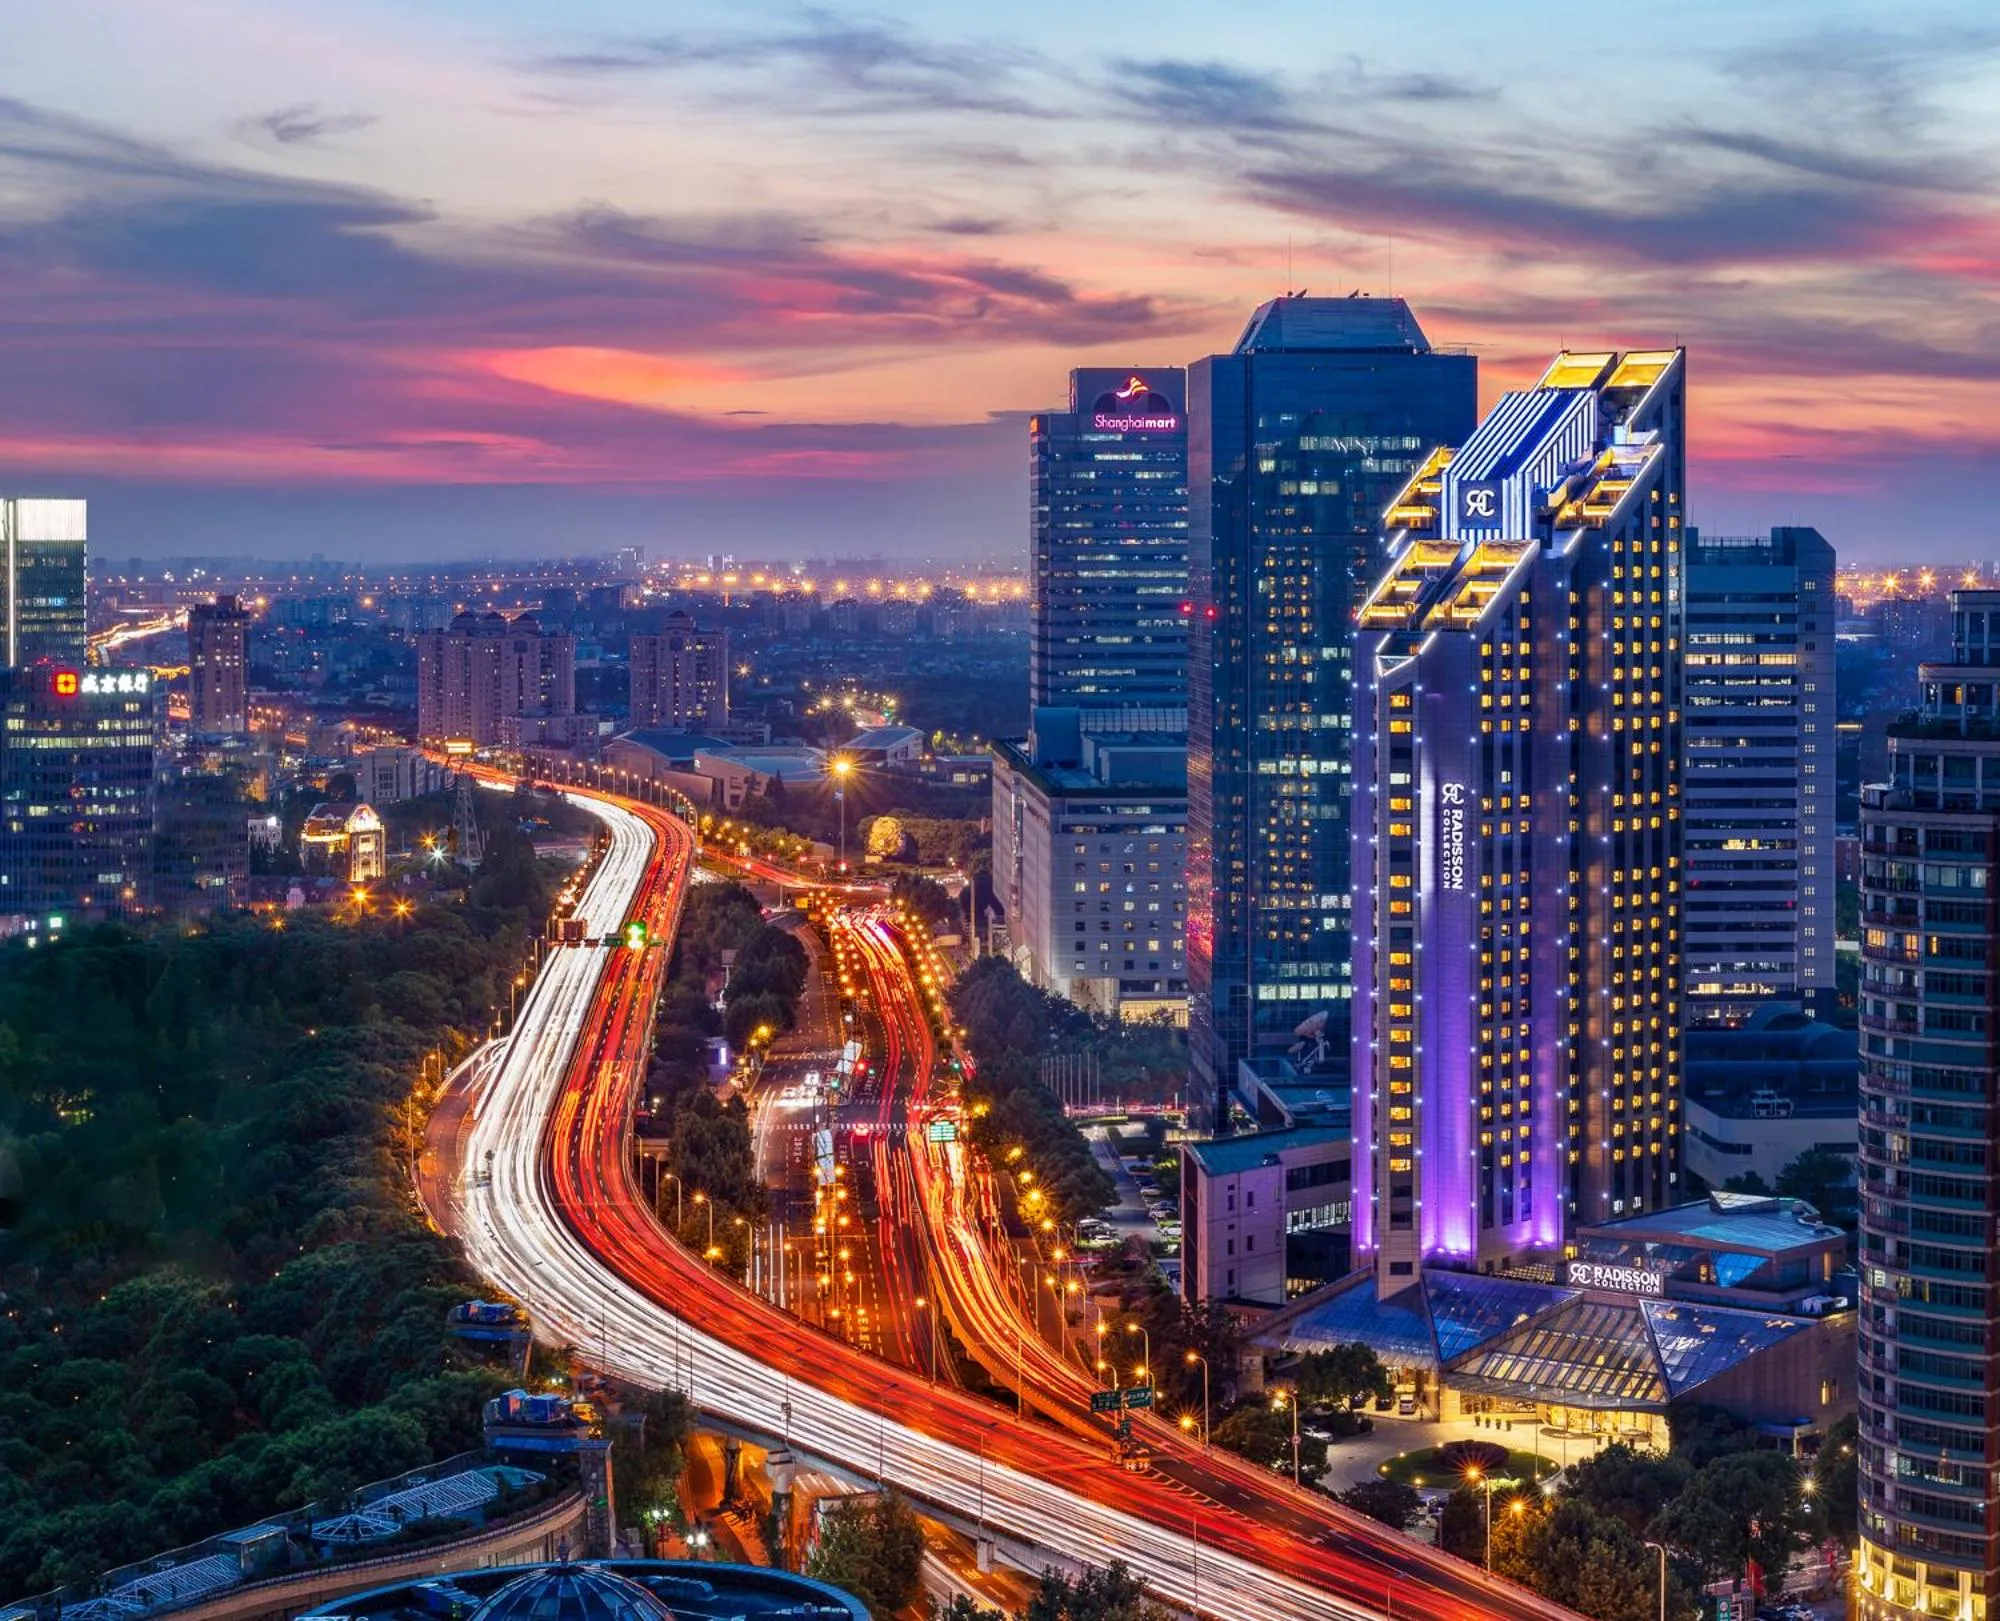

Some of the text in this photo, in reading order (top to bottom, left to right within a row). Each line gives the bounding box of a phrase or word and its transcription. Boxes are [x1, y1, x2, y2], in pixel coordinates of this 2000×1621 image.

[1095, 414, 1176, 431] Shanghaimart
[1443, 808, 1451, 889] COLLECTION
[1451, 809, 1463, 890] RADISSON
[1594, 1266, 1660, 1286] RADISSON
[1594, 1279, 1660, 1294] COLLECTION
